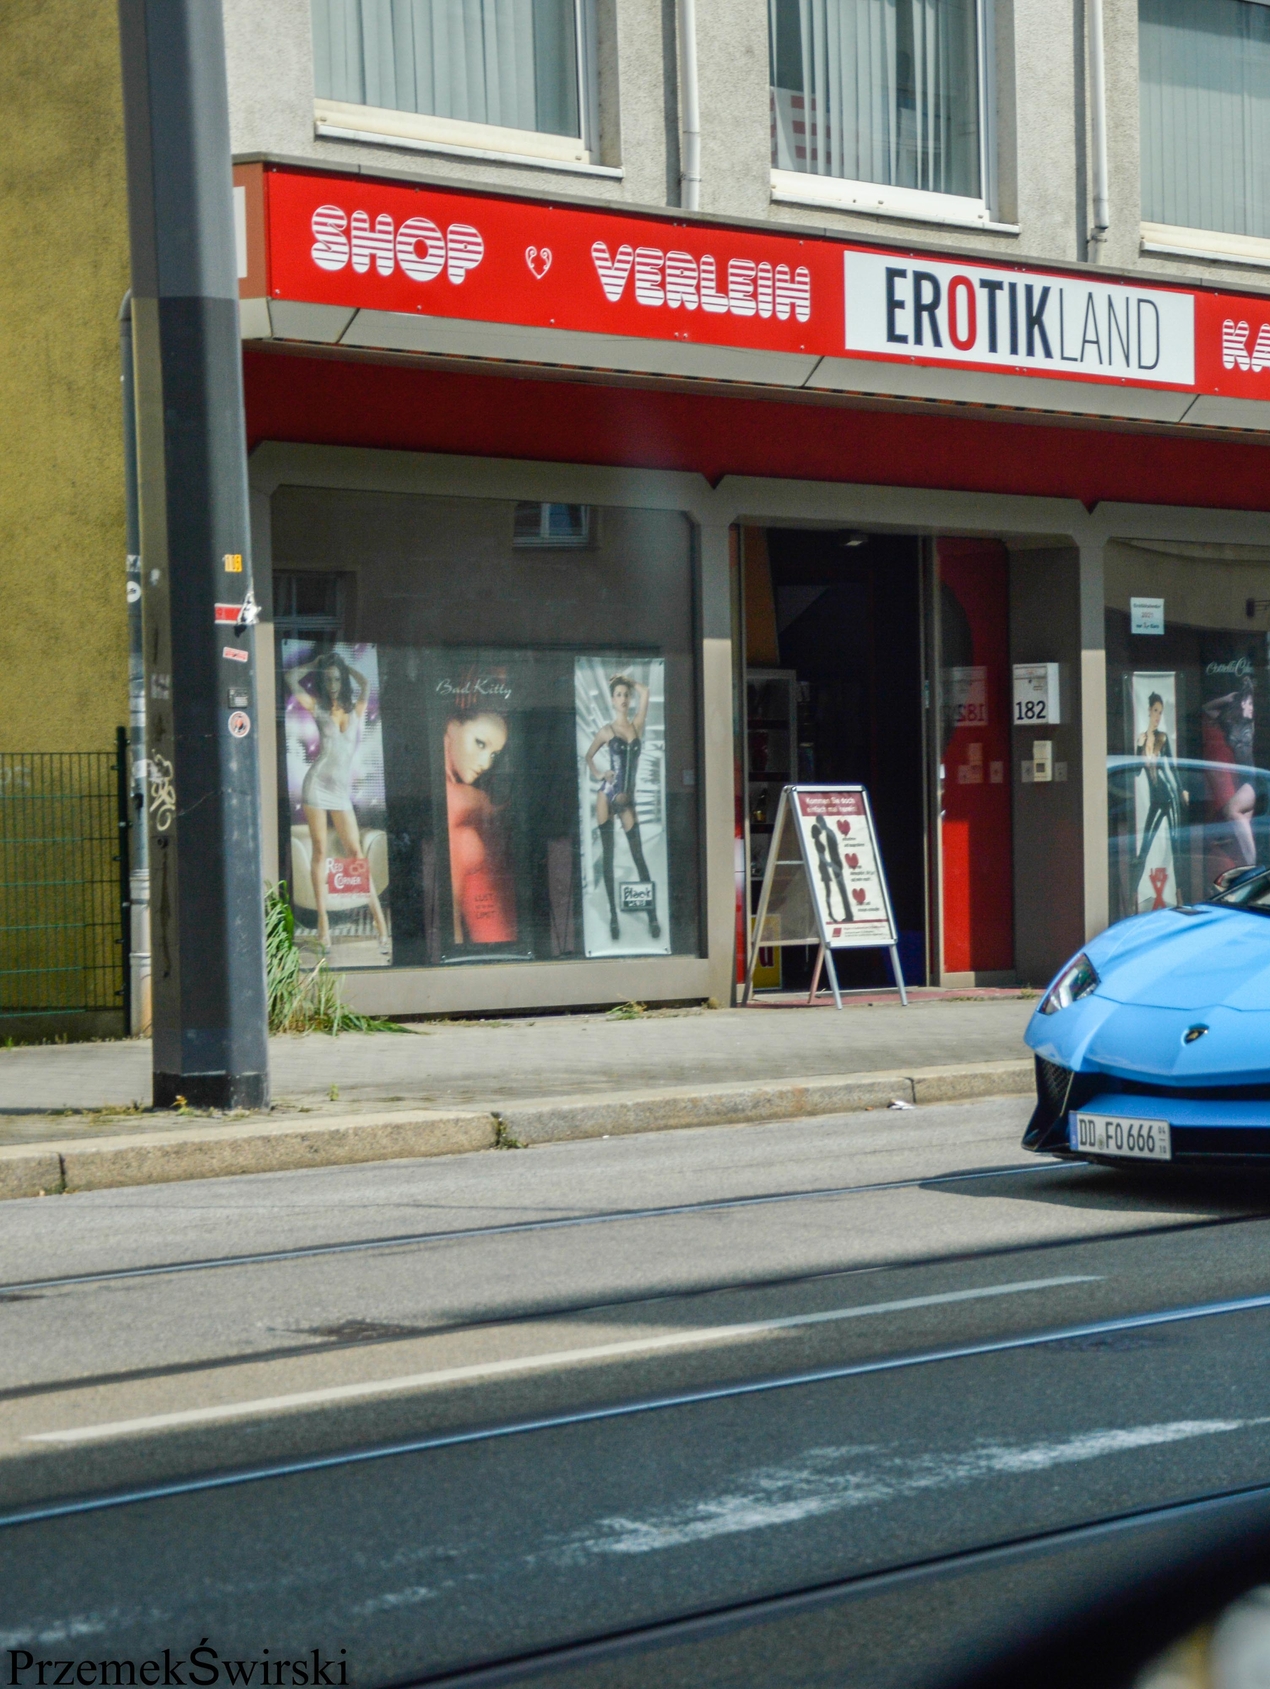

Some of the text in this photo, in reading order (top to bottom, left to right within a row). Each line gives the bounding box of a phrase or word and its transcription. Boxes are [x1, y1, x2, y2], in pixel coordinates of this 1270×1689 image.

[311, 204, 485, 285] SHOP
[591, 241, 811, 323] VERLEIH
[885, 266, 1161, 371] EROTIKLAND
[436, 678, 513, 700] Bad Kitty
[1015, 700, 1047, 721] 182
[1078, 1118, 1096, 1148] DD
[1127, 1123, 1156, 1153] 666
